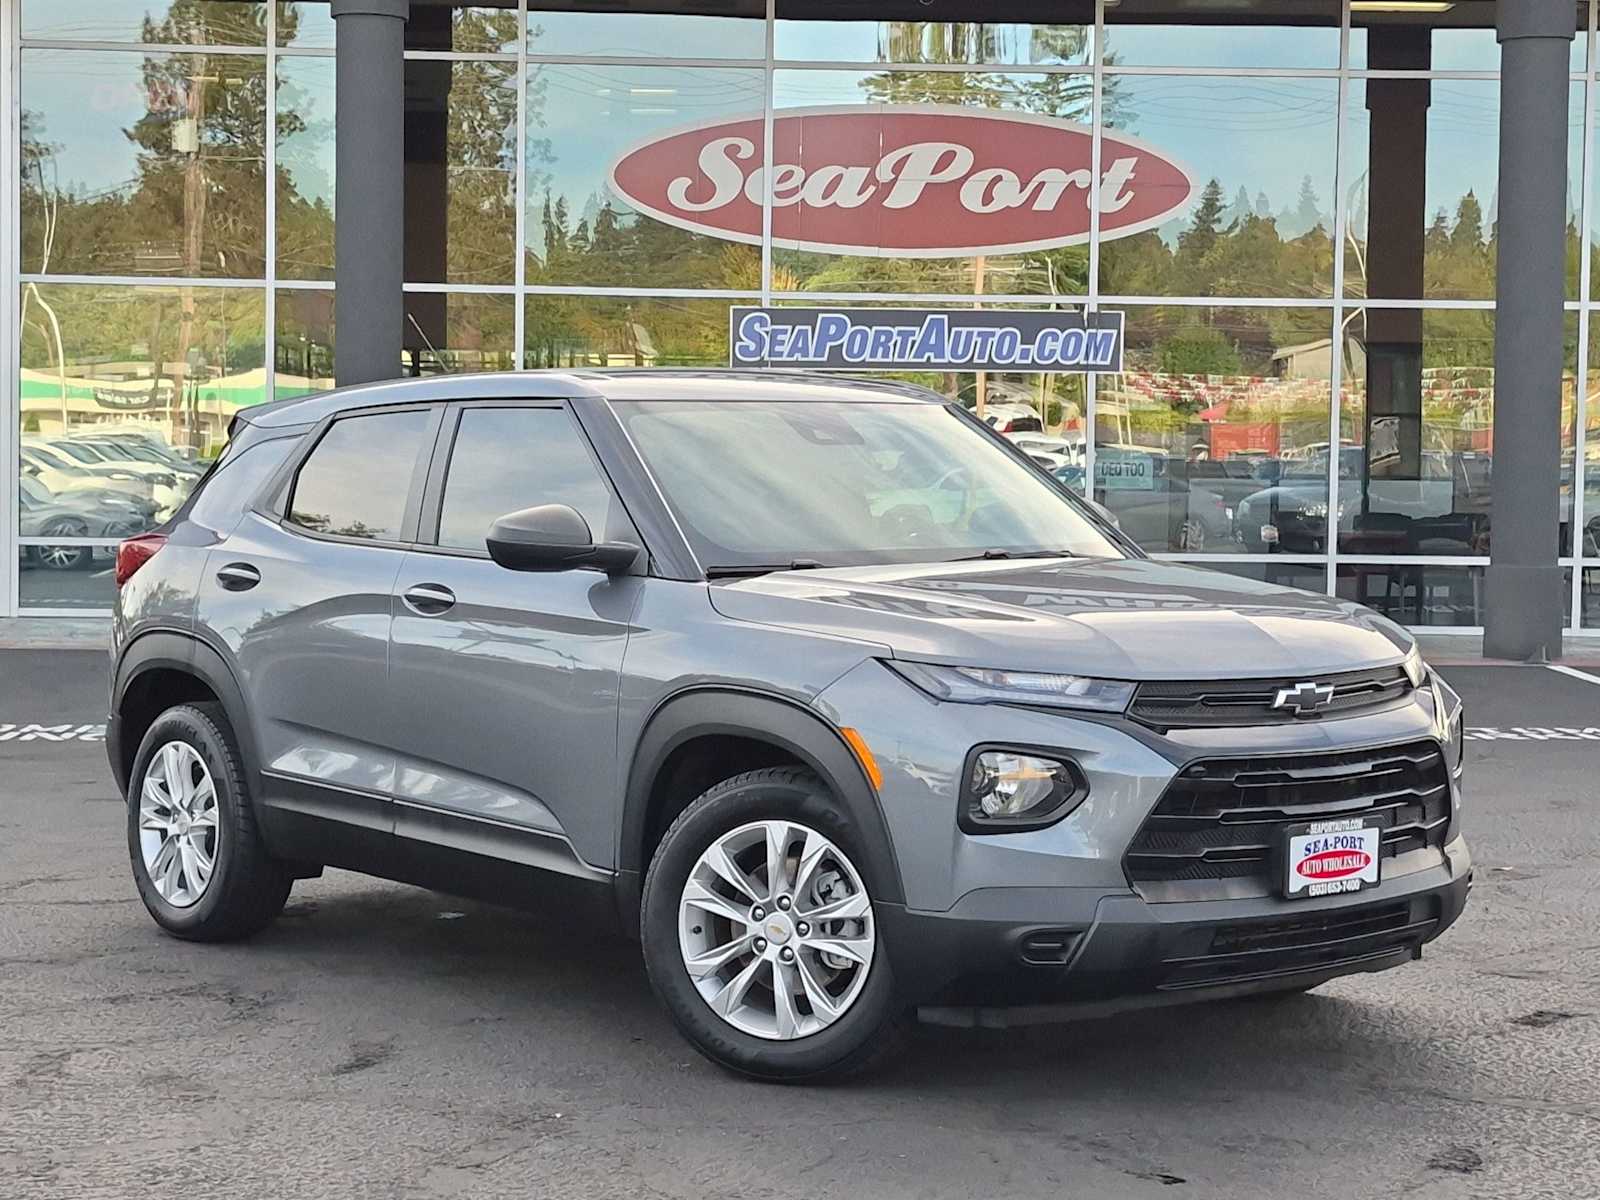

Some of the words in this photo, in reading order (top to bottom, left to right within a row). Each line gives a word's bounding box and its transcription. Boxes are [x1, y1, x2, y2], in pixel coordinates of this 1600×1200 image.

[666, 135, 1139, 214] SeaPort
[1301, 859, 1321, 875] AUTO
[1322, 853, 1366, 871] WHOLESALE
